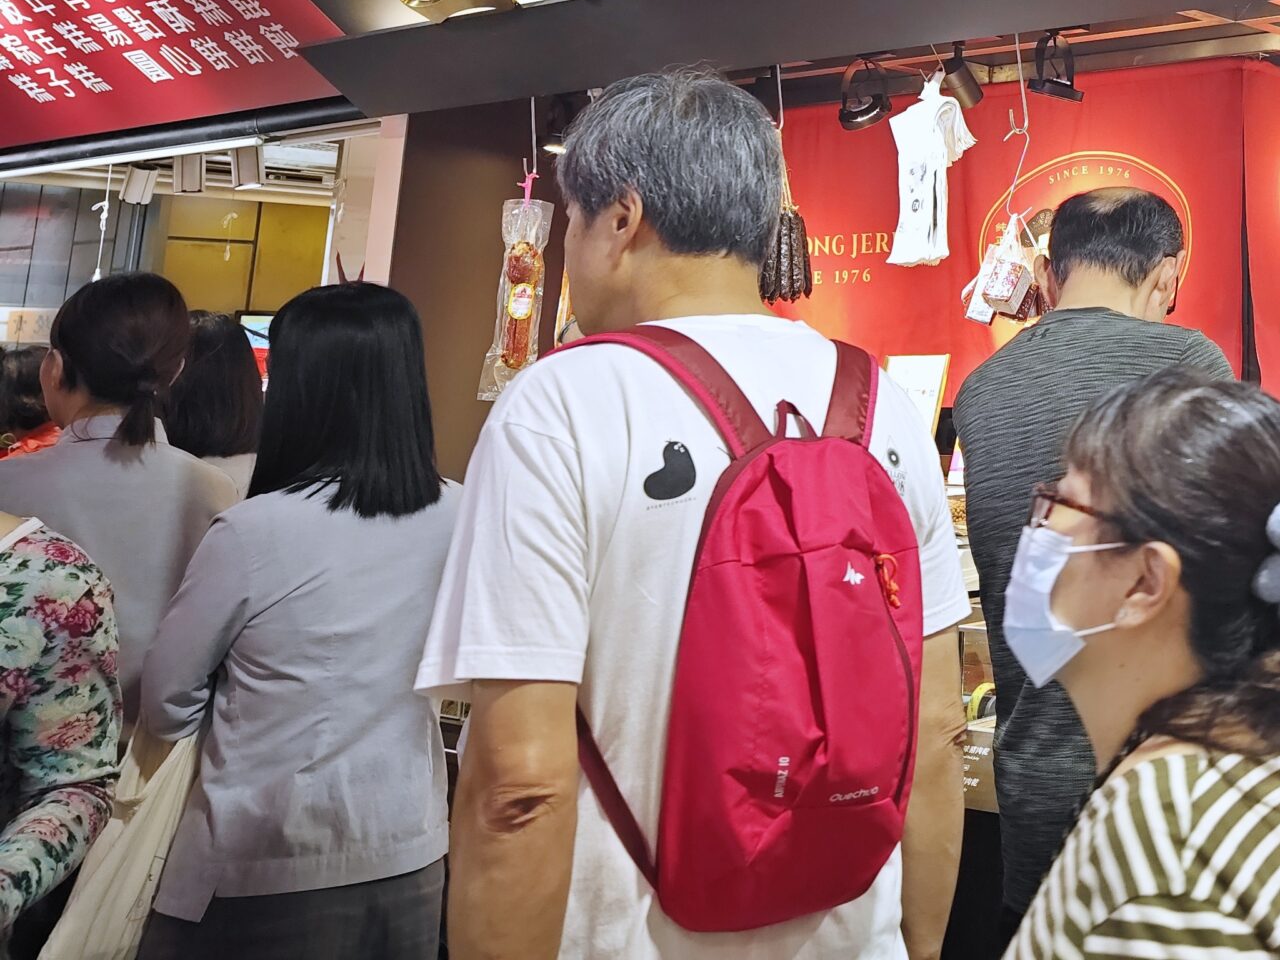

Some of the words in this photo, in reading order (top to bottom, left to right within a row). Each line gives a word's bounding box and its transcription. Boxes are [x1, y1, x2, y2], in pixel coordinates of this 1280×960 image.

[1048, 165, 1089, 185] SINCE
[1099, 165, 1131, 179] 1976
[851, 231, 898, 259] JER
[834, 268, 871, 284] 1976
